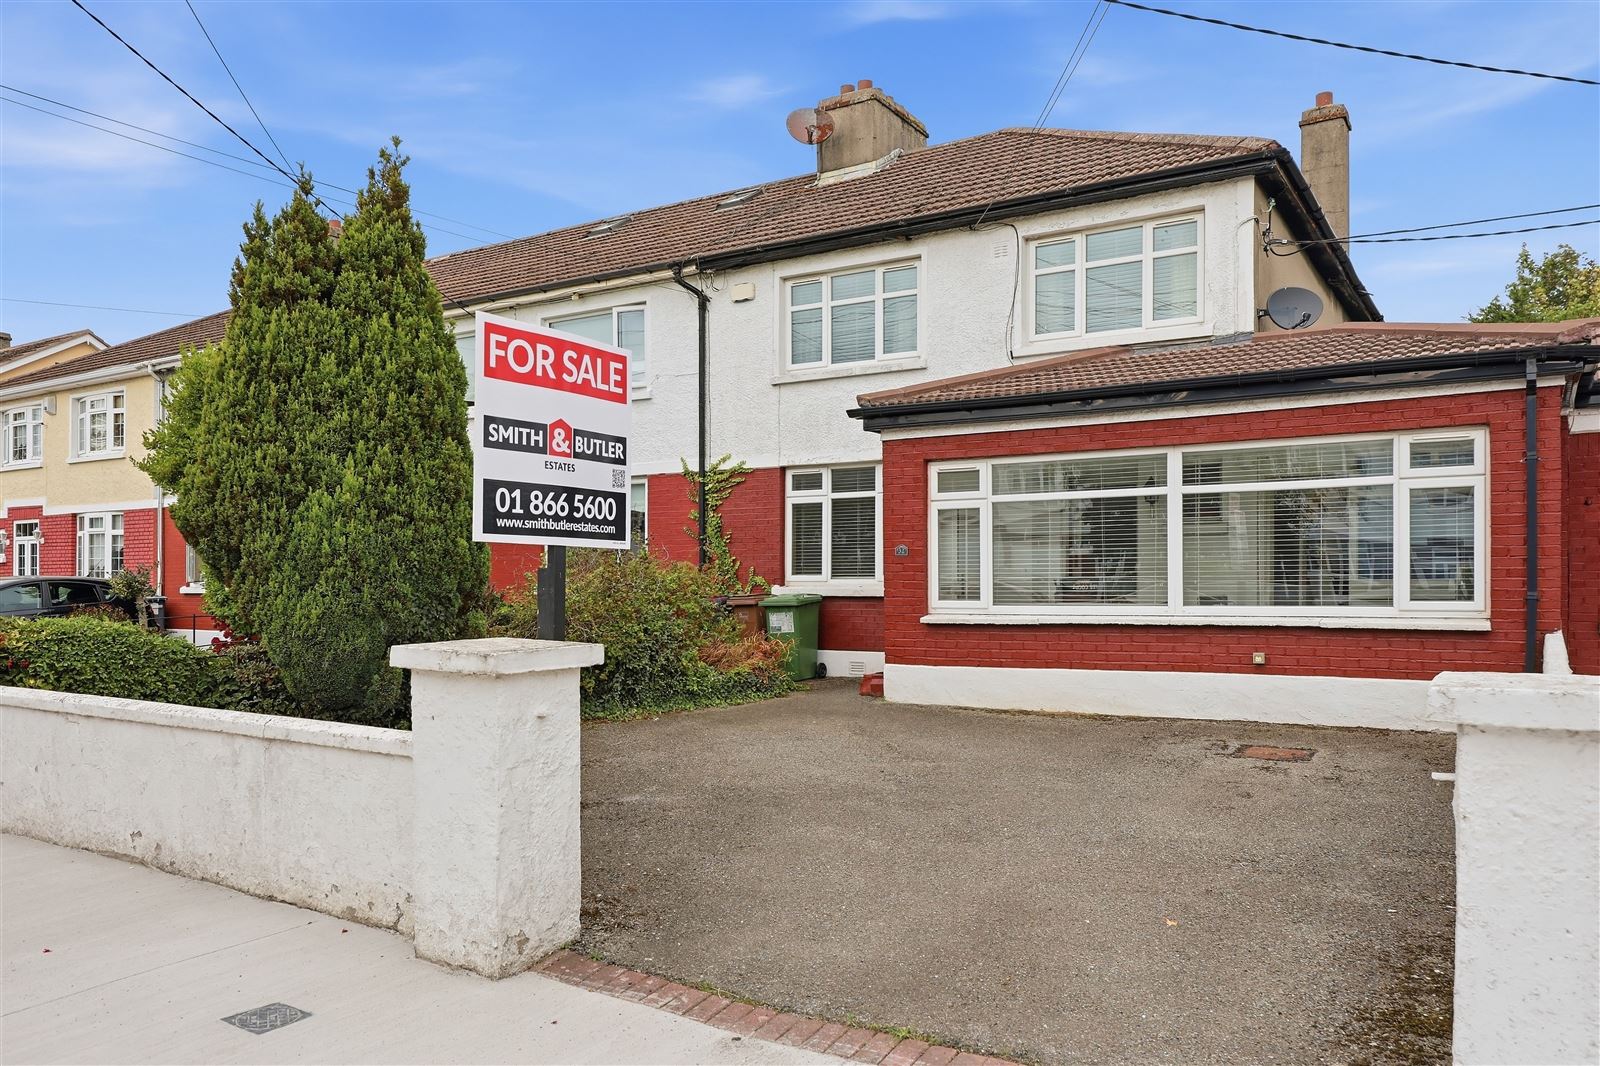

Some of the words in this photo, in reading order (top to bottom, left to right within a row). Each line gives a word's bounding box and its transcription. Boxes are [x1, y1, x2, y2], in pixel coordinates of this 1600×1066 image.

[489, 333, 556, 379] FOR
[562, 349, 623, 394] SALE
[488, 423, 543, 448] SMITH
[551, 428, 571, 453] &
[575, 435, 624, 460] BUTLER
[544, 460, 576, 473] ESTATES
[495, 487, 524, 514] 01
[529, 490, 569, 517] 866
[573, 494, 617, 521] 5600
[496, 517, 616, 534] www.smithbutlerestates.com
